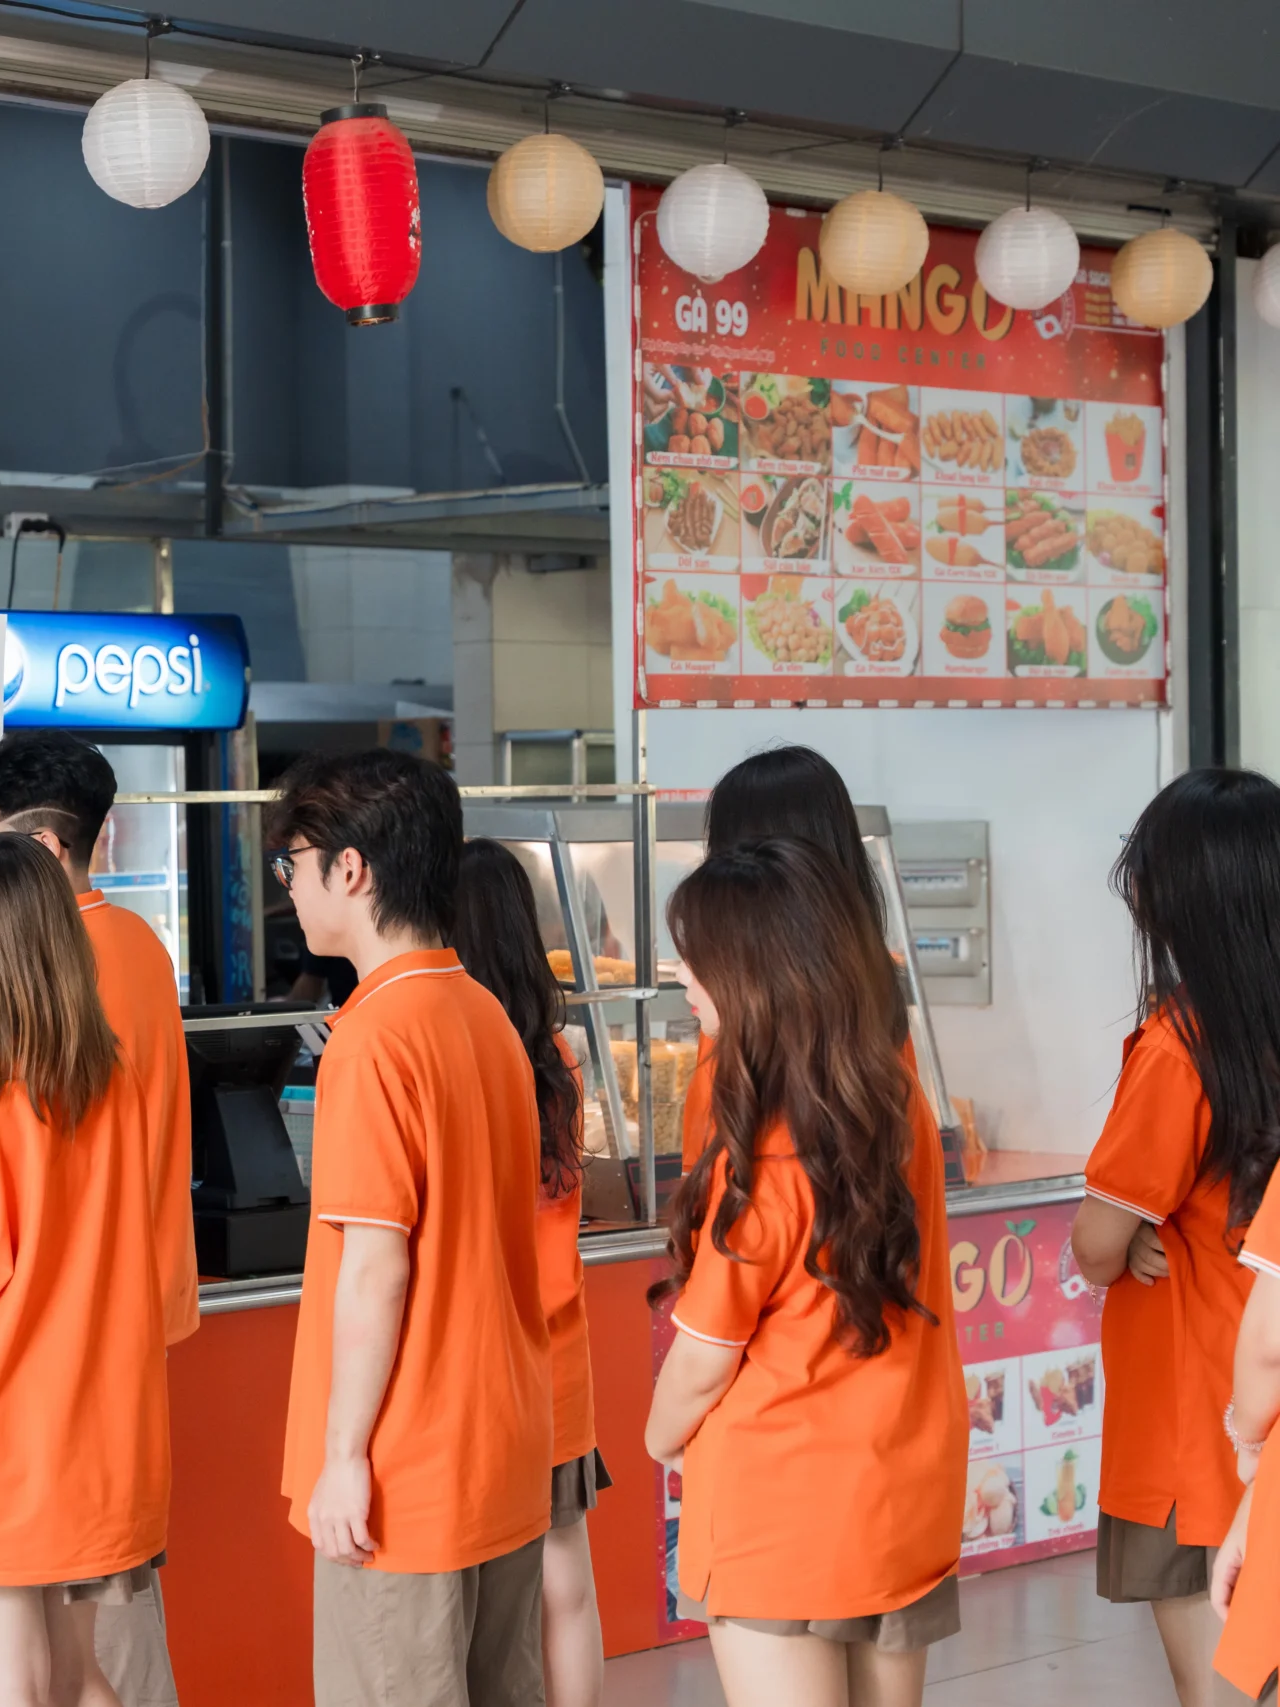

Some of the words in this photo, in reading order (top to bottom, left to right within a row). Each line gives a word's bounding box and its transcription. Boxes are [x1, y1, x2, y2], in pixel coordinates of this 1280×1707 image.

[675, 289, 708, 333] GÀ
[715, 300, 749, 337] 99
[821, 337, 881, 361] FOOD
[897, 346, 986, 370] CENTER
[56, 635, 203, 708] pepsi
